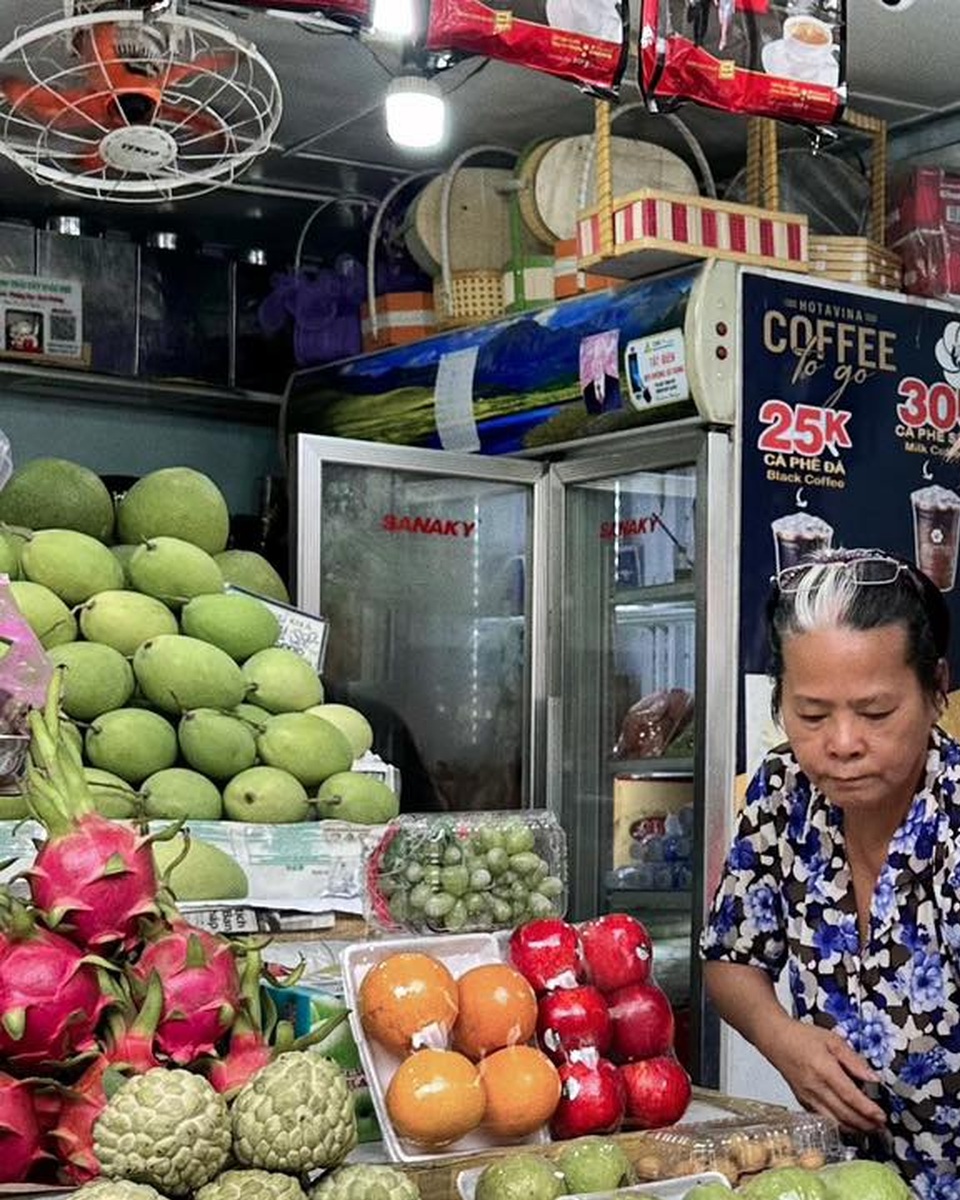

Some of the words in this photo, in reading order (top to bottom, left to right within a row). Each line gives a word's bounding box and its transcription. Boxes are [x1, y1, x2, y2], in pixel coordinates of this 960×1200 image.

[800, 300, 864, 321] HOTAVINA
[763, 310, 898, 372] COFFEE
[824, 363, 876, 409] go
[758, 399, 852, 457] 25K
[765, 469, 802, 485] Black
[804, 473, 846, 490] Coffee
[378, 514, 475, 538] SANAKY
[599, 516, 658, 540] SANAKY
